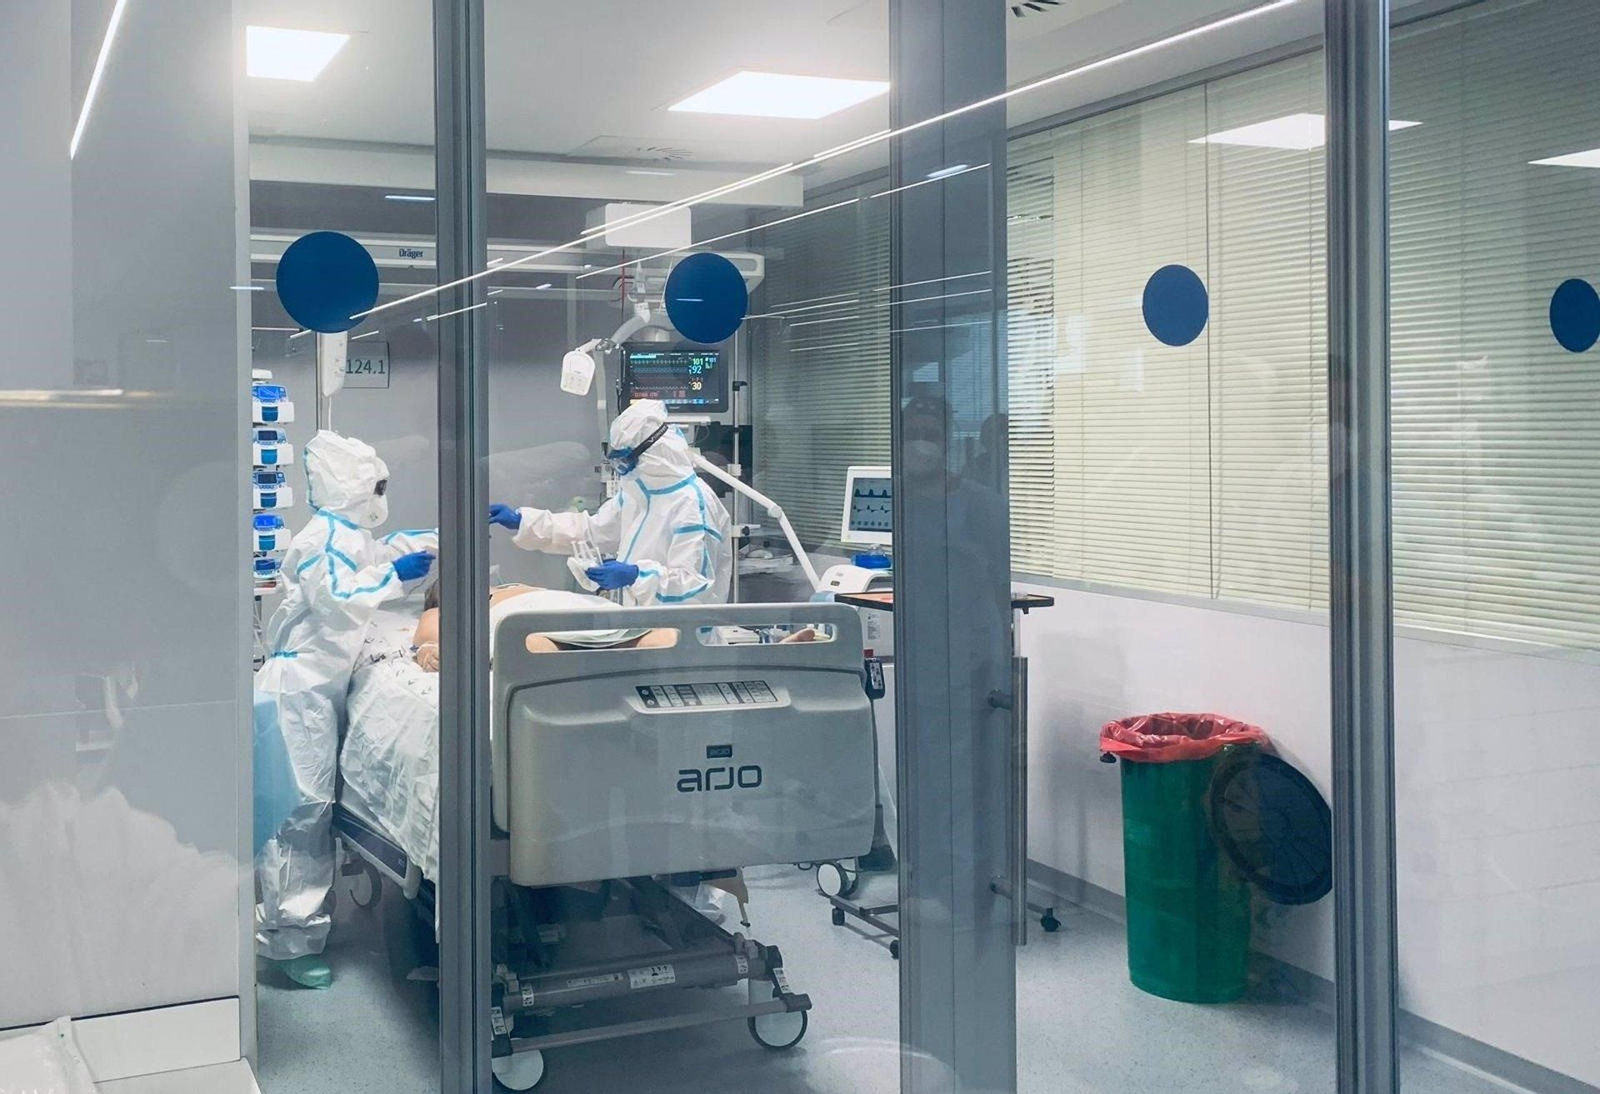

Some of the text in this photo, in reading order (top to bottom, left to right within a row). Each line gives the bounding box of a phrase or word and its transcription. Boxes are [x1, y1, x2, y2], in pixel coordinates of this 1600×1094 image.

[399, 248, 423, 259] Dräger
[692, 365, 702, 373] 92
[692, 382, 702, 390] 30
[676, 765, 763, 792] arjo
